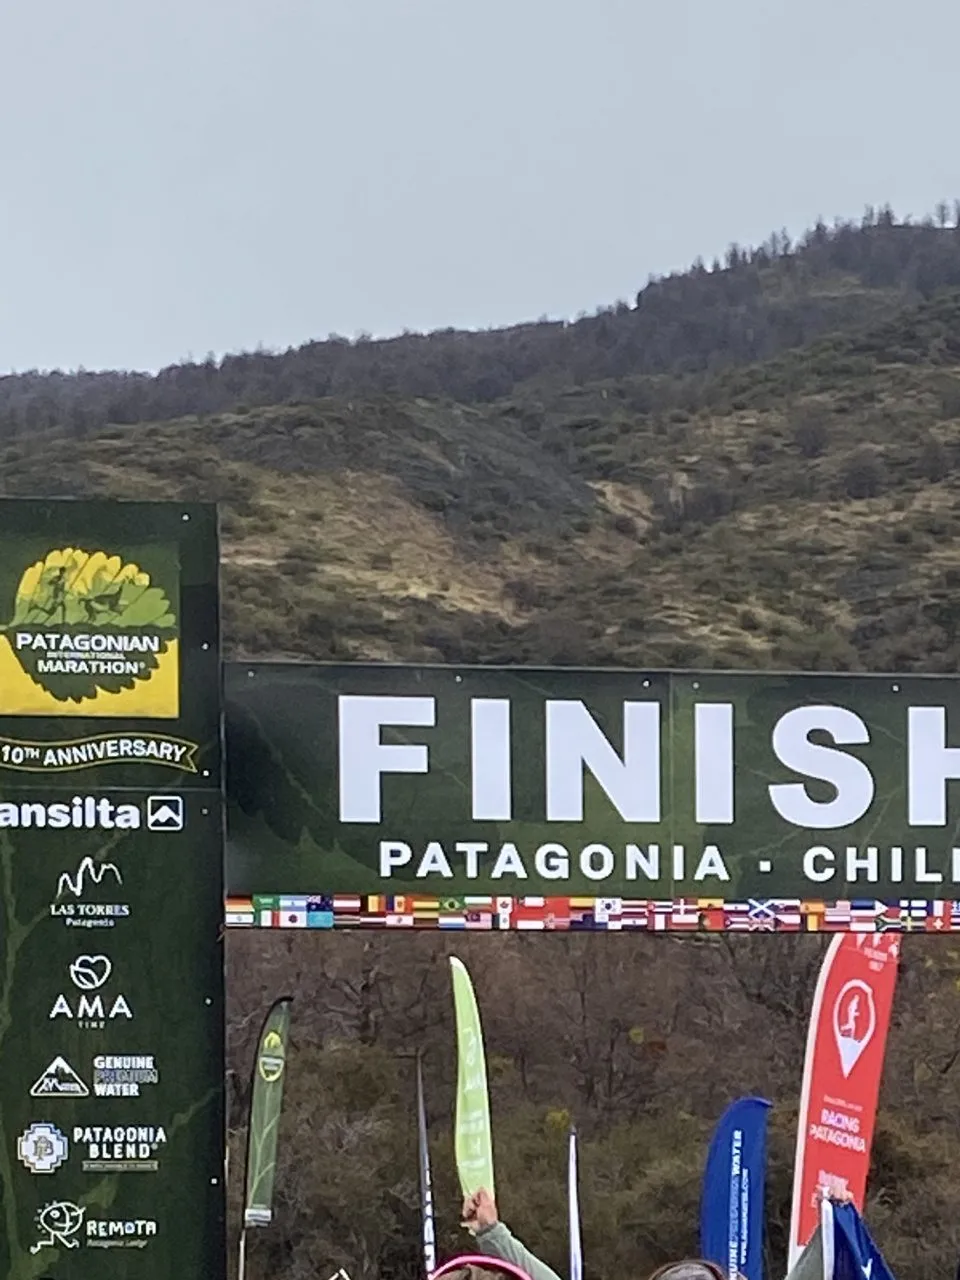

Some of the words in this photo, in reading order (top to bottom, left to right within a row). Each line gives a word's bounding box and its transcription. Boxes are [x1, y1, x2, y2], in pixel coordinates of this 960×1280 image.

[16, 632, 159, 652] PATAGONIAN
[1, 744, 41, 764] 10TH
[43, 739, 188, 767] ANNIVERSARY
[0, 796, 141, 830] ansilta
[379, 841, 730, 881] PATAGONIA
[50, 904, 75, 916] LAS
[77, 904, 130, 916] TORRES
[50, 994, 133, 1019] AMA
[93, 1055, 154, 1069] GENUINE
[94, 1083, 140, 1097] WATER
[73, 1126, 167, 1143] PATAGONIA
[86, 1220, 157, 1237] REMOTA
